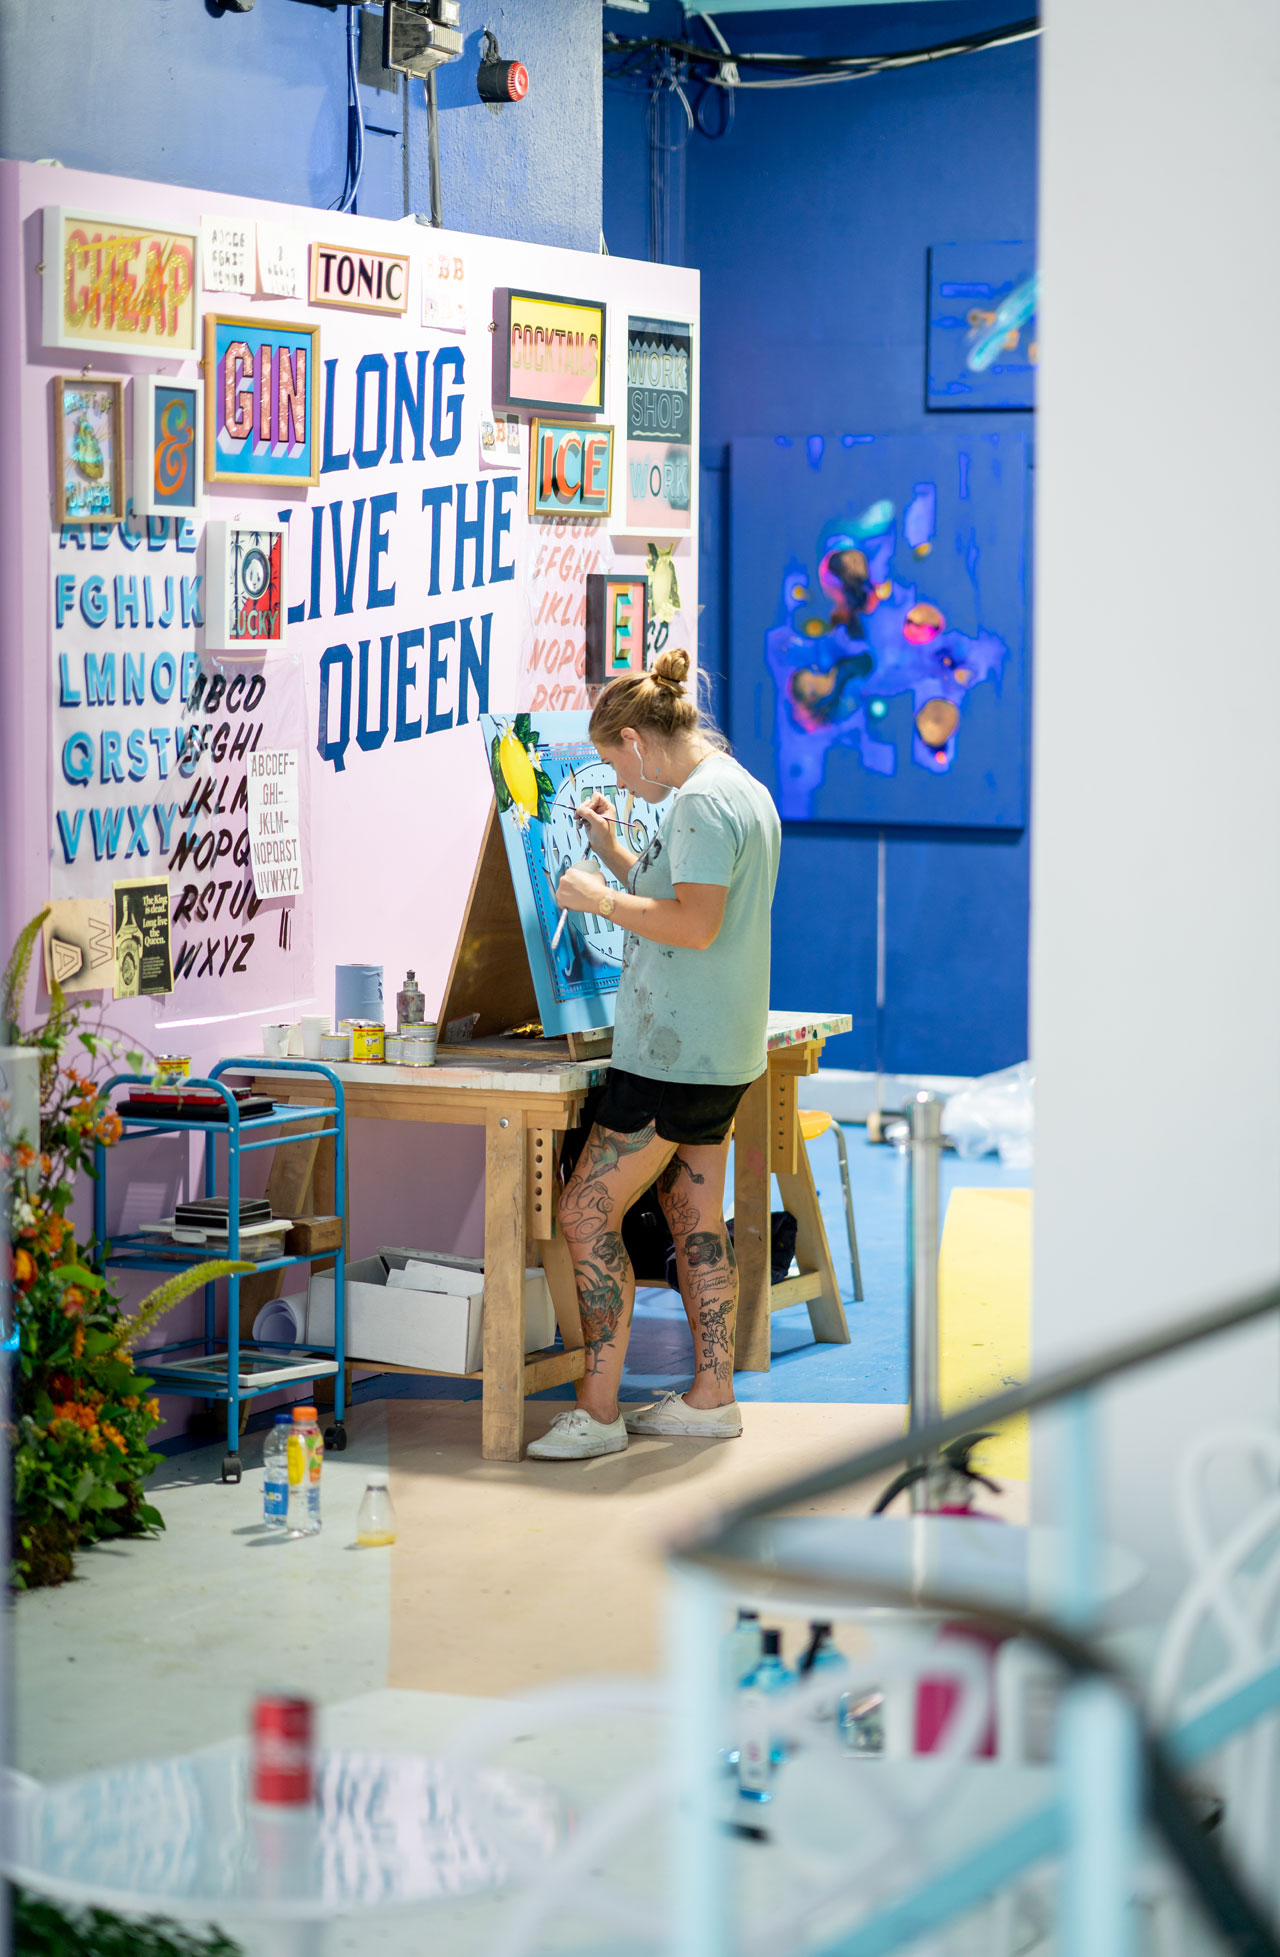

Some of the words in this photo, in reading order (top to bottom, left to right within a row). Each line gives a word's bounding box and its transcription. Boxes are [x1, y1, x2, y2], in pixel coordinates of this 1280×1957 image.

[64, 229, 192, 337] CHEAP
[319, 252, 403, 301] TONIC
[512, 322, 599, 379] COCKTAILS
[629, 350, 688, 390] WORK
[221, 340, 307, 448] GIN
[320, 345, 465, 474] LONG
[631, 390, 684, 429] SHOP
[154, 398, 194, 496] &
[540, 430, 608, 504] ICE
[629, 462, 689, 500] WORK
[421, 475, 518, 596] THE
[55, 574, 205, 629] FGHIJK
[229, 609, 279, 636] LUCKY
[612, 584, 633, 669] E
[59, 651, 202, 707] LMNOP
[317, 612, 494, 772] QUEEN
[254, 839, 297, 865] NOPQRST
[257, 868, 299, 894] UVWXYZ
[143, 918, 157, 928] Long
[145, 936, 166, 947] Queen.
